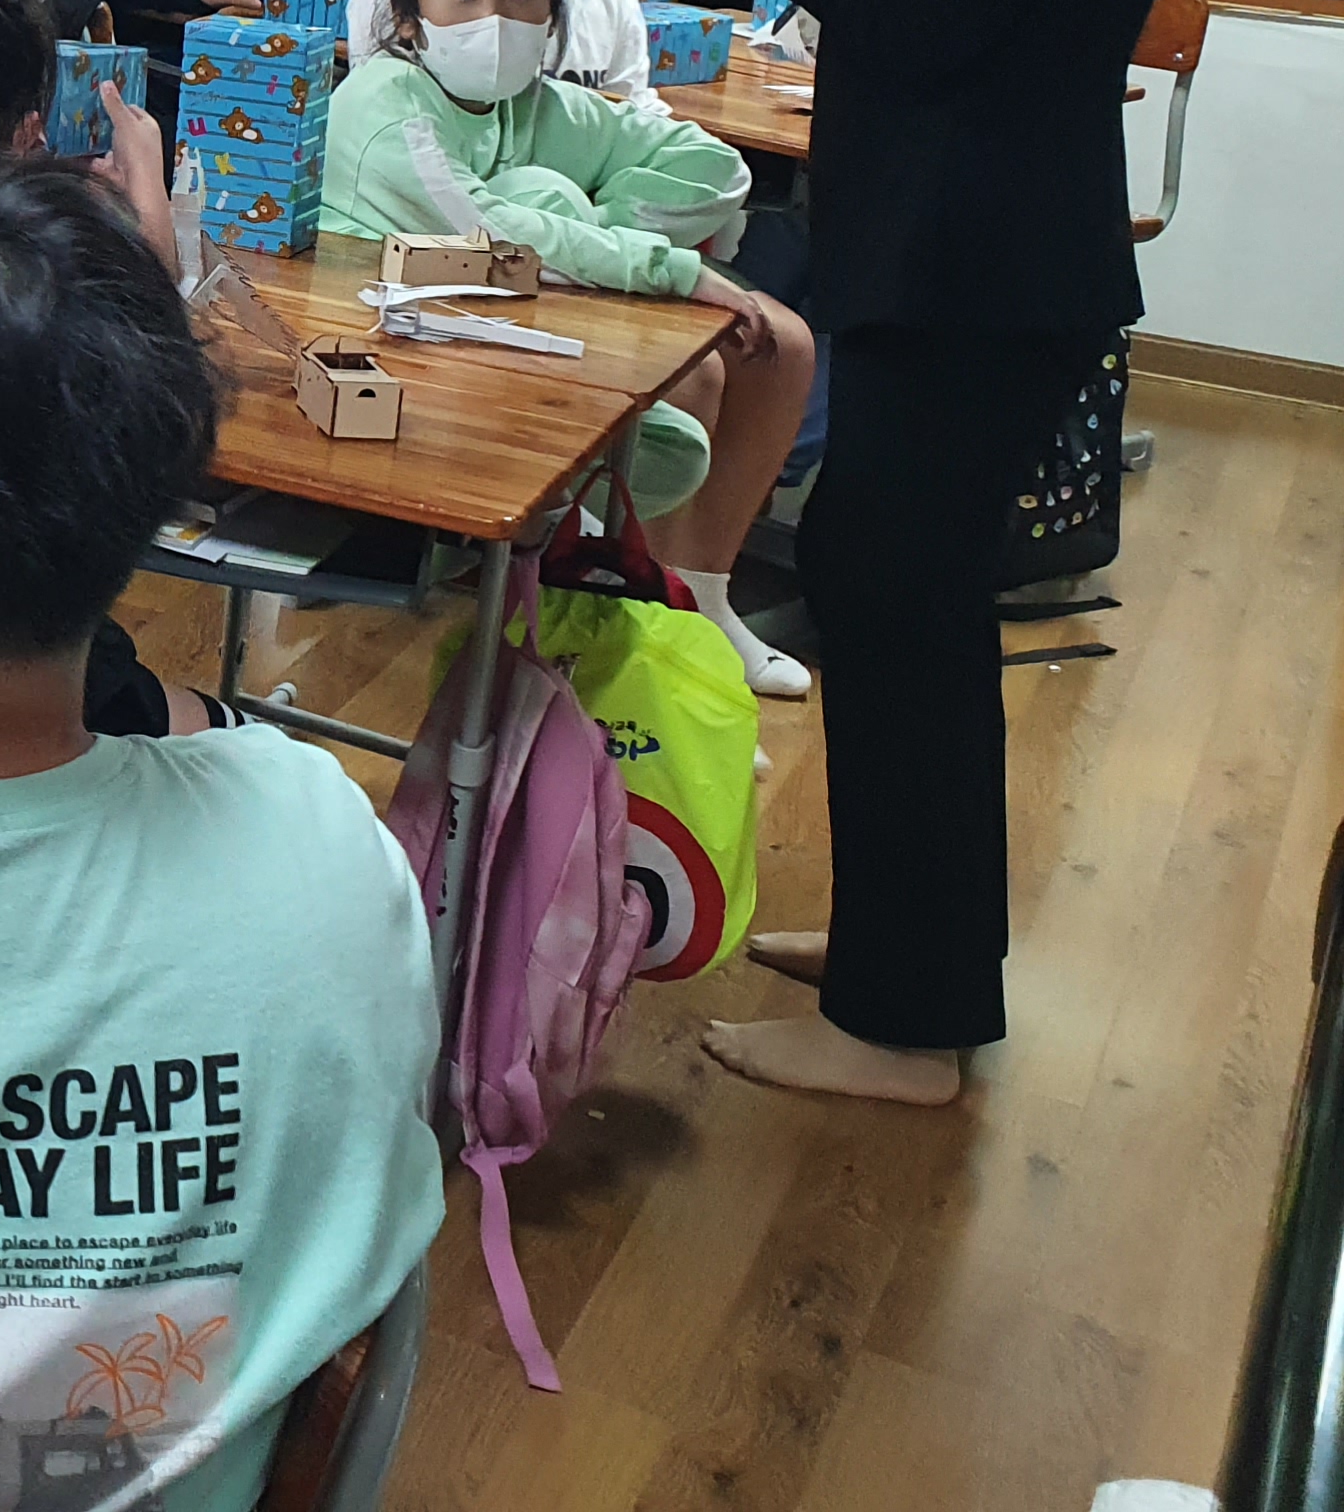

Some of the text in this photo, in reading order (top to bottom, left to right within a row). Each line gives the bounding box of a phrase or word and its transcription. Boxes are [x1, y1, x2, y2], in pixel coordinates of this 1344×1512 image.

[94, 1133, 239, 1216] LIFE
[2, 1235, 49, 1251] place
[55, 1235, 71, 1249] to
[78, 1237, 140, 1250] escape
[14, 1255, 106, 1271] something
[112, 1257, 147, 1268] new
[31, 1275, 63, 1288] find
[70, 1276, 98, 1288] the
[103, 1273, 141, 1288] start
